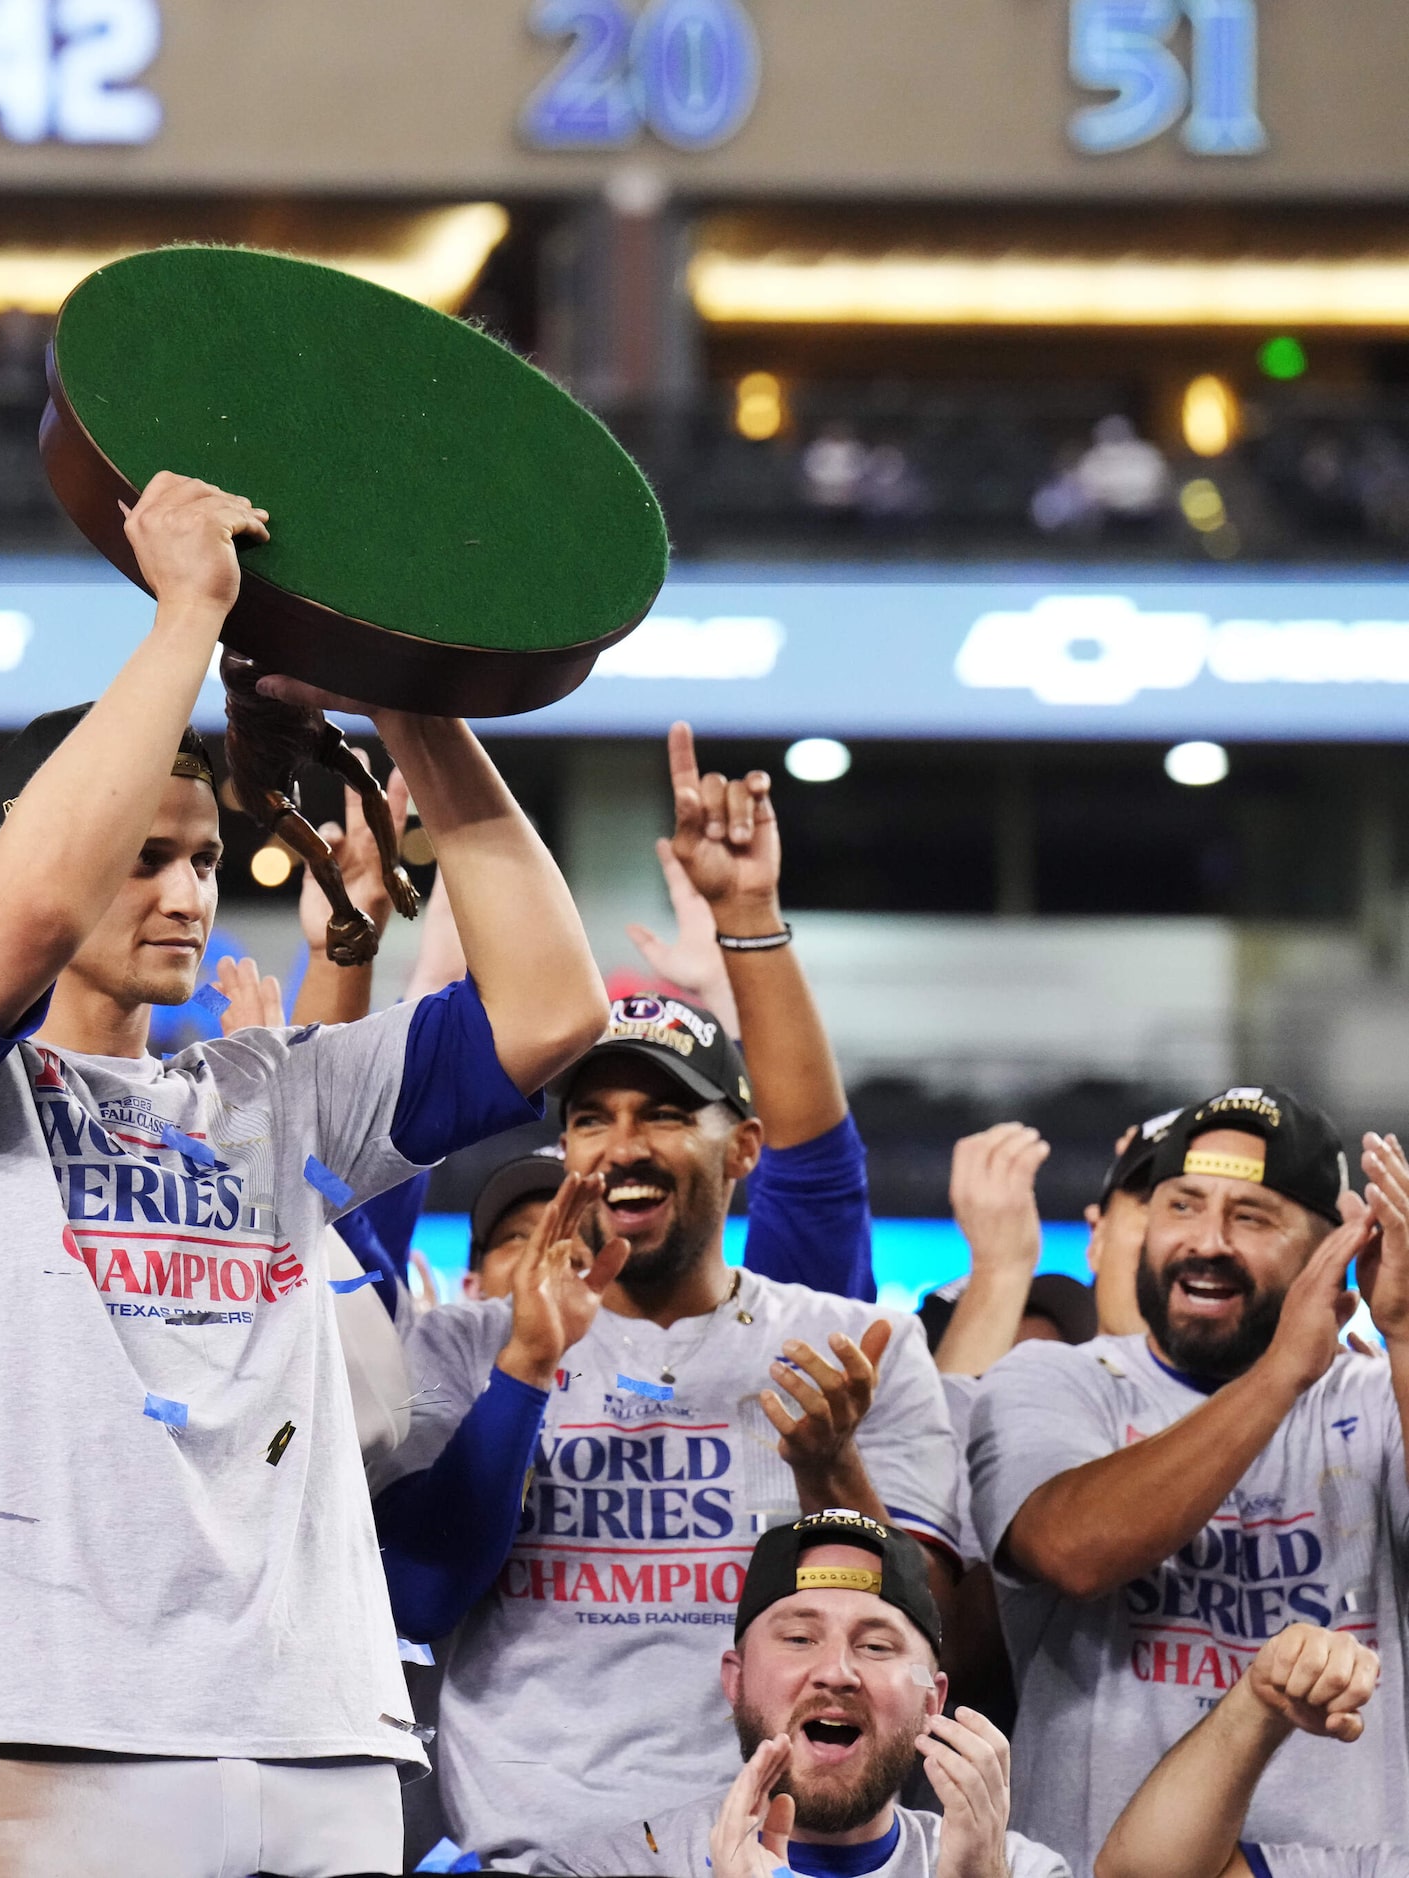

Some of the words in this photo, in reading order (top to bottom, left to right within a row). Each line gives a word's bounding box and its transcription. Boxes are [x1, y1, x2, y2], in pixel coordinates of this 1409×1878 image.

[520, 0, 761, 150] 20
[1067, 0, 1268, 154] 51
[100, 1108, 137, 1124] FALL
[136, 1112, 177, 1134] CLASS
[55, 1163, 243, 1232] ERIES
[105, 1303, 170, 1318] TEXAS
[174, 1309, 253, 1325] RERS
[792, 1515, 888, 1539] CHAMPS
[1178, 1526, 1322, 1582] OLD
[574, 1611, 640, 1625] TEXAS
